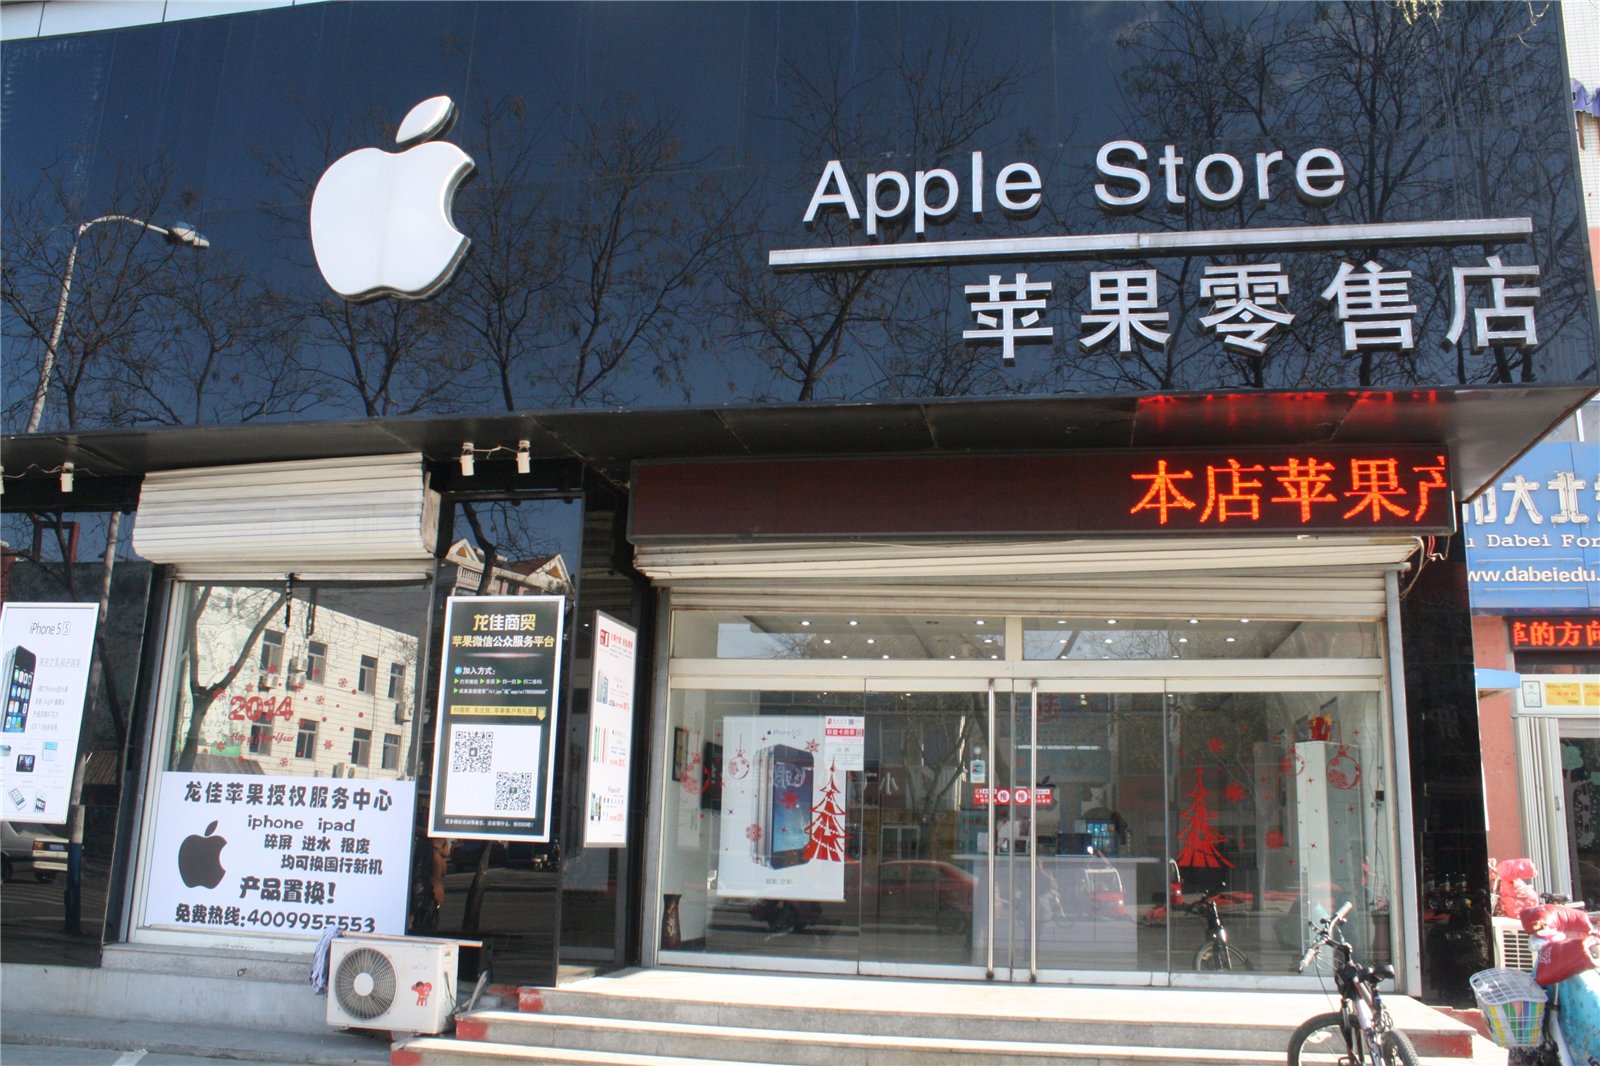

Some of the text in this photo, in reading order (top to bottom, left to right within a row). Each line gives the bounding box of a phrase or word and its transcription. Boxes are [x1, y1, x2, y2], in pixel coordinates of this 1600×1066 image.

[803, 140, 1347, 237] Apple Store
[963, 256, 1541, 364] 苹果零售店
[1487, 534, 1552, 548] Dabei
[472, 613, 537, 632] 龙佳商贸
[452, 635, 555, 648] 苹果微信公众服务平台
[228, 695, 294, 721] 2014
[184, 780, 393, 812] 龙佳苹果授权服务中心
[247, 815, 356, 832] iphone ipad
[264, 834, 371, 854] 碎屏 进水 报废
[280, 855, 384, 875] 均可换国行新机
